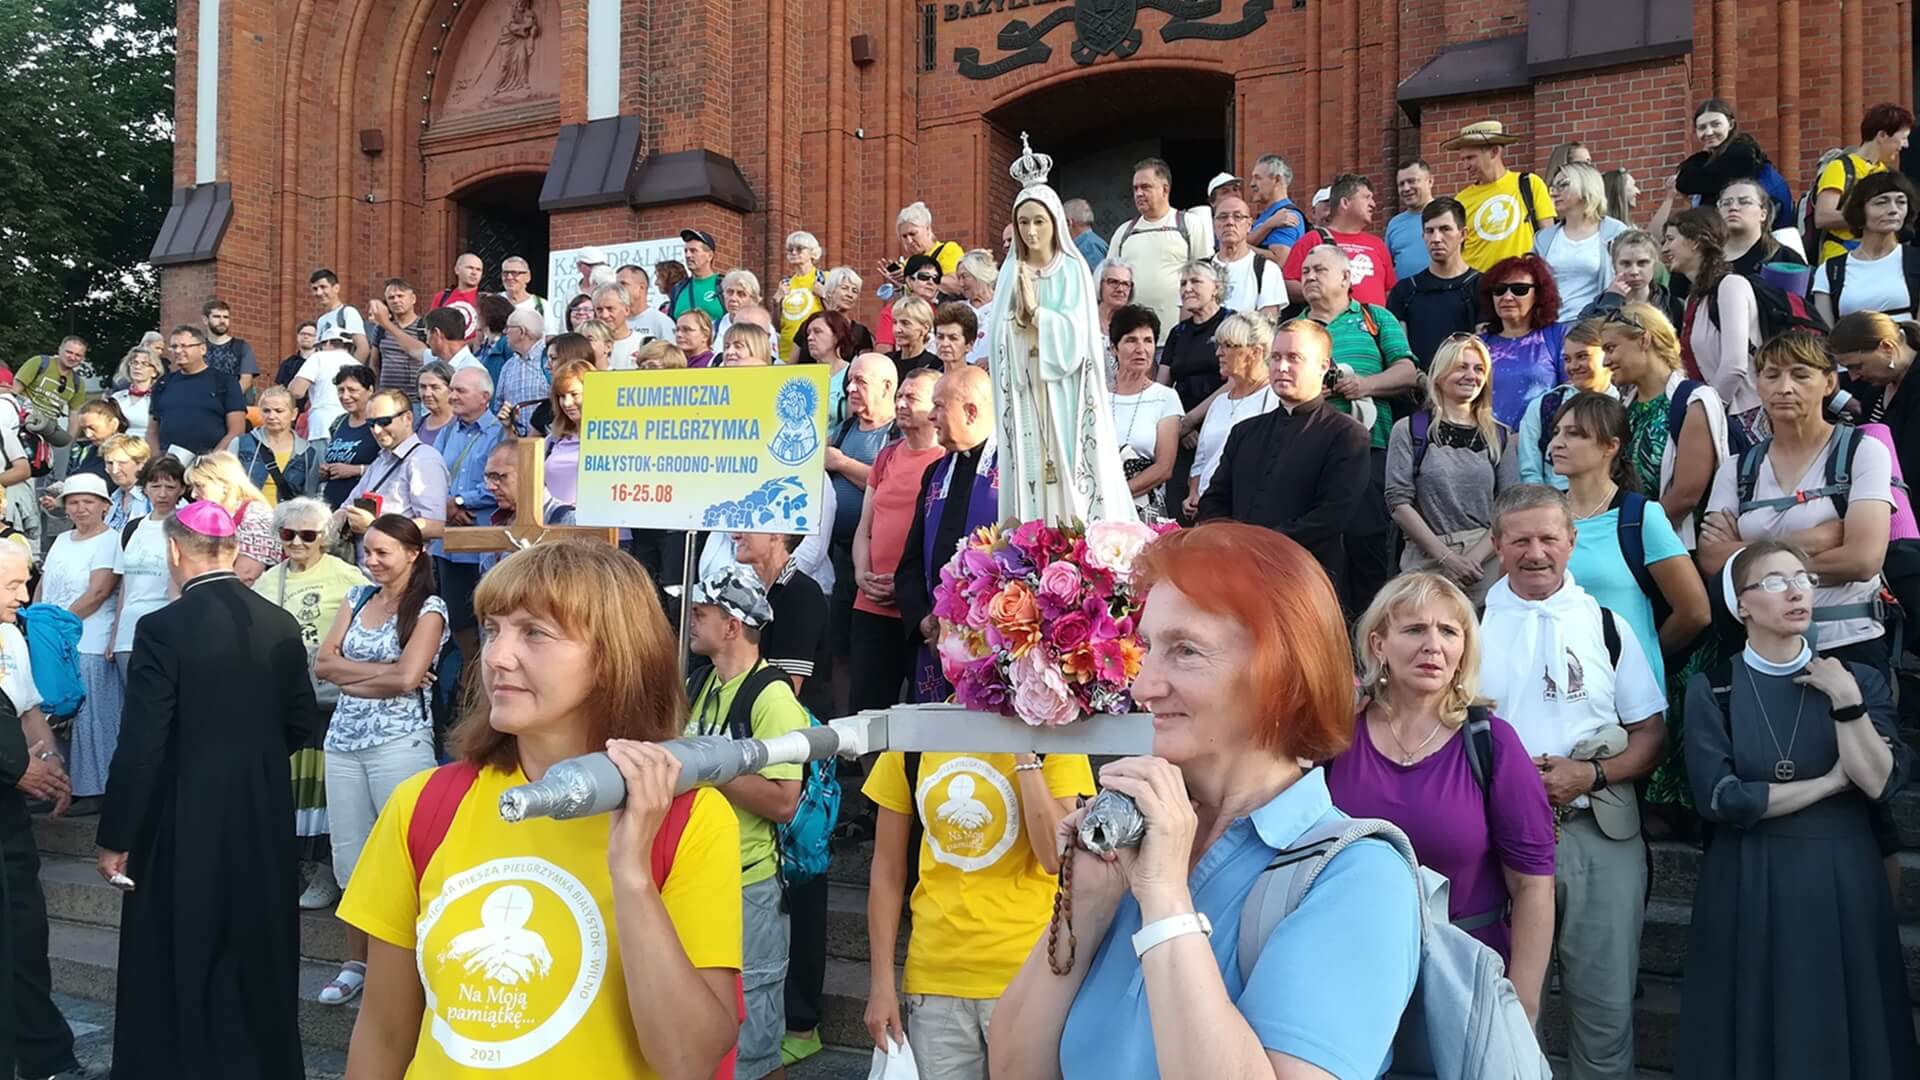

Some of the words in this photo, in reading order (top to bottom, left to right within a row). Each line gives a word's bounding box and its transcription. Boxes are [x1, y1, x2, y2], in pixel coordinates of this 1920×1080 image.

[554, 245, 685, 277] KADRALNE
[616, 384, 730, 407] EKUMENICZNA
[587, 419, 638, 440] PIESZA
[645, 419, 760, 440] PIELGRZYMKA
[584, 455, 758, 474] BIAŁYSTOK-GRODNO-WILNO
[610, 483, 673, 503] 16-25.08
[503, 863, 574, 893] PIELGRZYMKA
[572, 891, 601, 948] BIAŁYSTOK
[579, 958, 601, 1000] WILNO
[458, 983, 481, 1003] Na
[487, 985, 528, 1011] Moją
[470, 1047, 502, 1063] 2021
